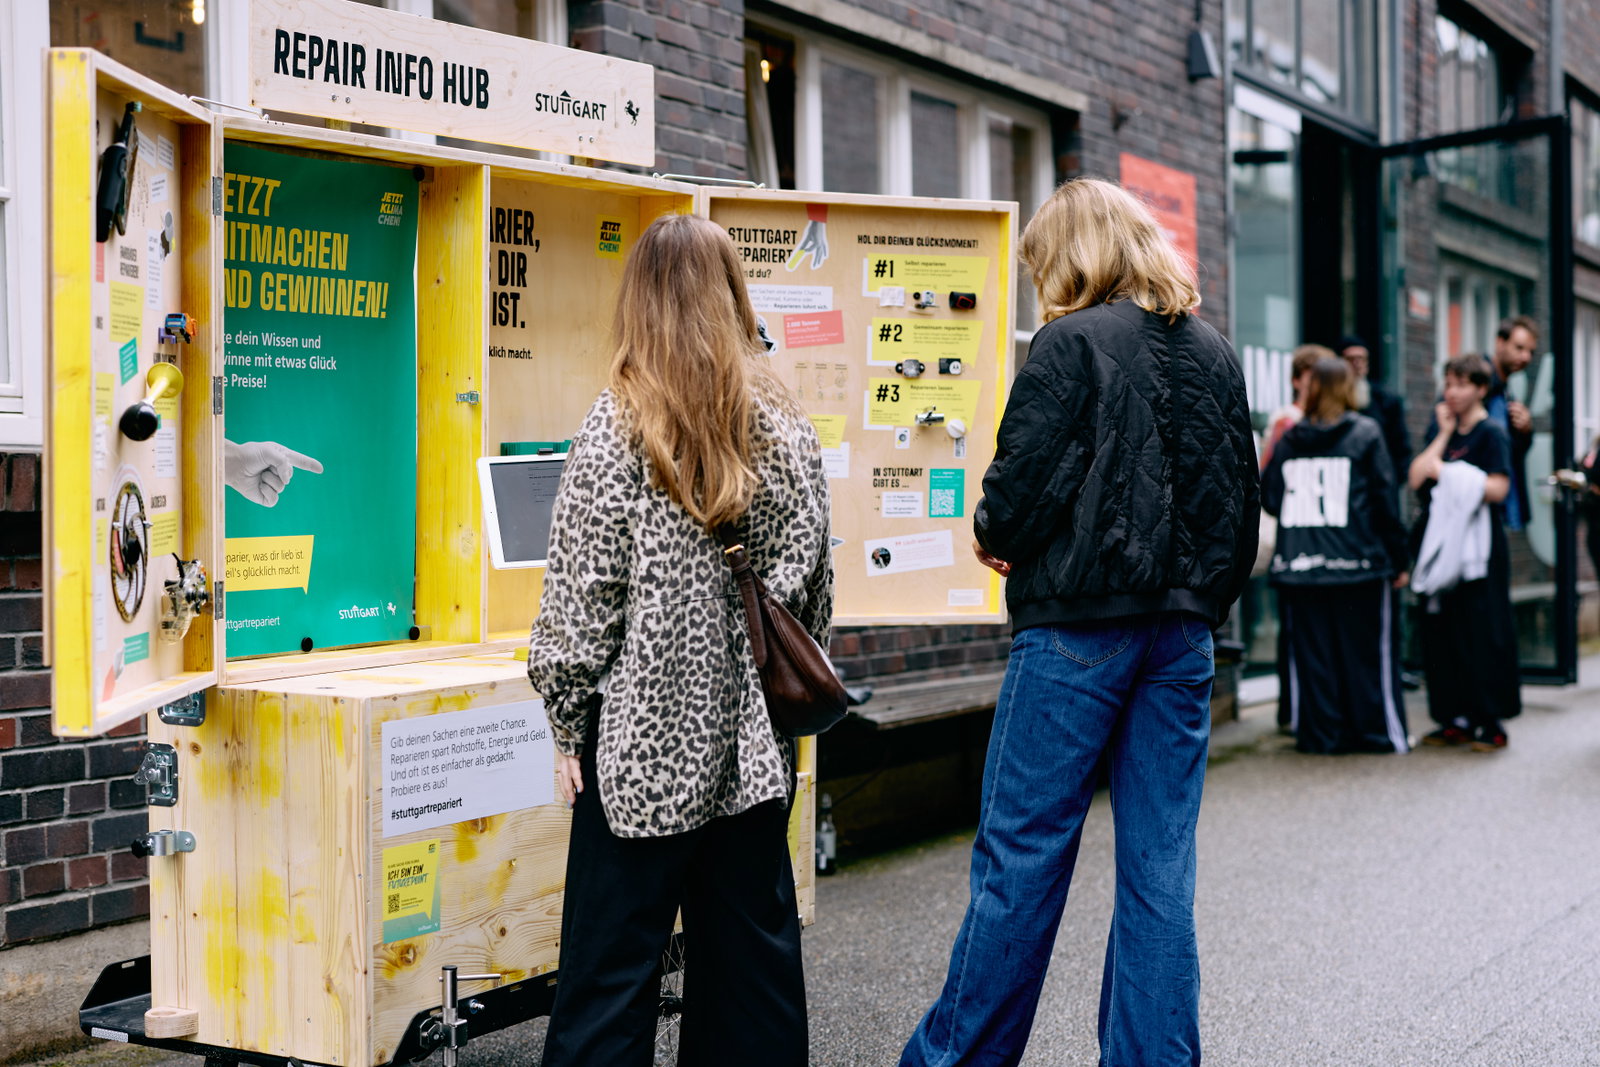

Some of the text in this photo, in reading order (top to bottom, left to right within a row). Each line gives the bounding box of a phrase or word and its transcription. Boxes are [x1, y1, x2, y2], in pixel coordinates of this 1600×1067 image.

[274, 29, 490, 110] REPAIR INFO HUB
[535, 90, 607, 122] STUTTGART
[224, 172, 281, 217] ETZT
[381, 192, 403, 204] JETZT
[380, 203, 403, 215] KLIMA
[378, 214, 401, 226] CHEN!
[600, 221, 621, 232] JETZT
[490, 206, 540, 253] RIER,
[600, 231, 621, 243] KLIMA
[728, 227, 797, 245] STUTTGART
[598, 242, 620, 253] CHEN!
[857, 235, 979, 248] HOL DIR DEINEN GLÜCKSMOMENT!
[738, 247, 793, 263] PARIERT
[498, 249, 527, 288] DIR
[744, 268, 772, 278] nd du?
[874, 260, 894, 278] #1
[224, 268, 389, 319] ND GEWINNEN!
[492, 292, 526, 328] IST.
[235, 330, 258, 346] dein
[262, 332, 298, 347] Wissen
[302, 335, 321, 349] und
[879, 324, 903, 342] #2
[224, 351, 337, 370] inne mit etwas Glück
[489, 345, 533, 360] klich macht.
[231, 373, 267, 388] Preise!
[876, 384, 900, 402] #3
[873, 467, 923, 477] IN STUTTGART
[873, 478, 889, 488] GIBT
[891, 478, 900, 488] ES
[226, 552, 250, 565] parier,
[253, 553, 268, 561] was
[270, 550, 279, 560] dir
[281, 549, 294, 560] lieb
[225, 564, 300, 580] eil's glücklich macht.
[339, 605, 380, 620] STUTTGART
[226, 616, 280, 631] ttgartrepariert
[390, 719, 527, 749] Gib deinen Sachen eine zweite Chance.
[390, 728, 547, 766] Reparieren spart Rohstoffe, Energie und Geld.
[390, 750, 515, 782] Und oft ist es einfacher als gedacht.
[390, 777, 448, 797] Probiere es aus!
[391, 796, 463, 821] #stuttgartrepariert
[388, 869, 399, 881] ICH
[413, 864, 424, 875] EIN
